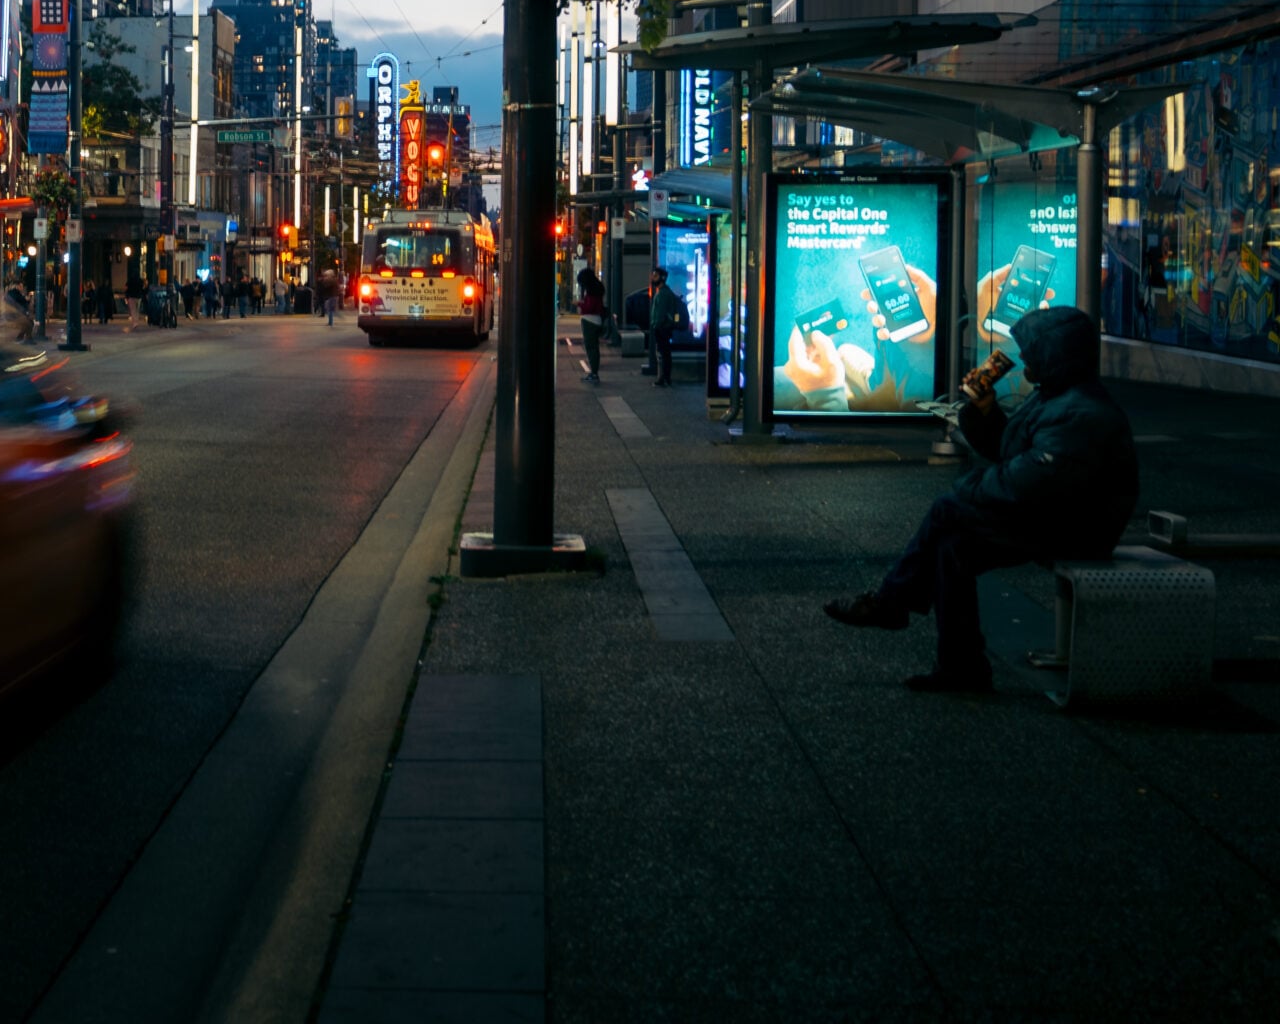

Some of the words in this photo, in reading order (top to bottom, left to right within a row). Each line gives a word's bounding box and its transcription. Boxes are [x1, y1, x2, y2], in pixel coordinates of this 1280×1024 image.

[224, 132, 254, 140] Robson
[256, 132, 264, 140] St
[406, 118, 420, 210] VOGU
[787, 193, 812, 208] Say
[814, 195, 837, 208] yes
[839, 194, 854, 206] to
[787, 207, 810, 221] the
[812, 207, 859, 223] Capital
[860, 207, 888, 221] One
[787, 222, 827, 235] Smart
[829, 221, 890, 235] Rewards
